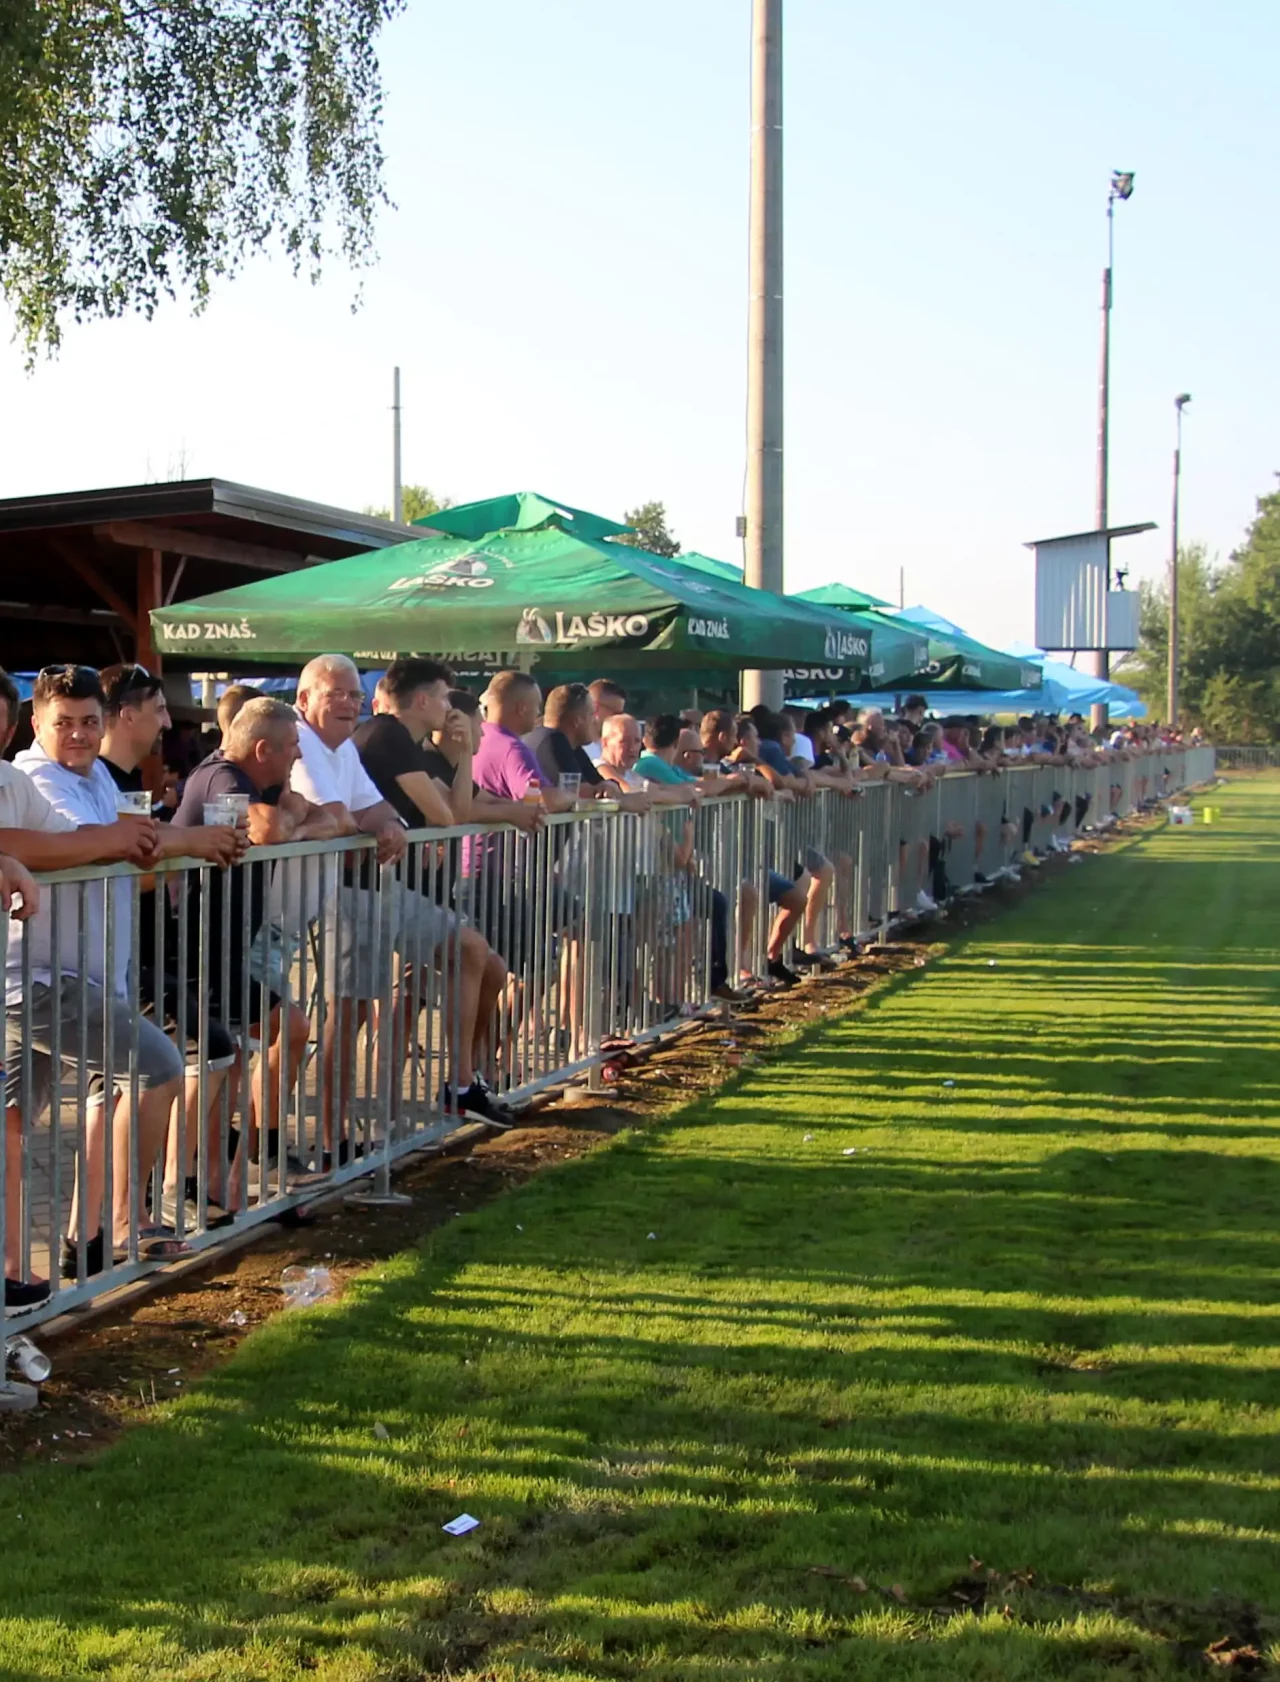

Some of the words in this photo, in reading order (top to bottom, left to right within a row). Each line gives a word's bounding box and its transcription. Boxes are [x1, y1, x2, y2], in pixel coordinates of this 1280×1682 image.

[163, 623, 201, 639] KAD
[204, 617, 257, 639] ZNAŠ.
[555, 611, 649, 644] LAŠKO
[687, 617, 706, 636] KAD
[837, 631, 868, 660] LAŠKO
